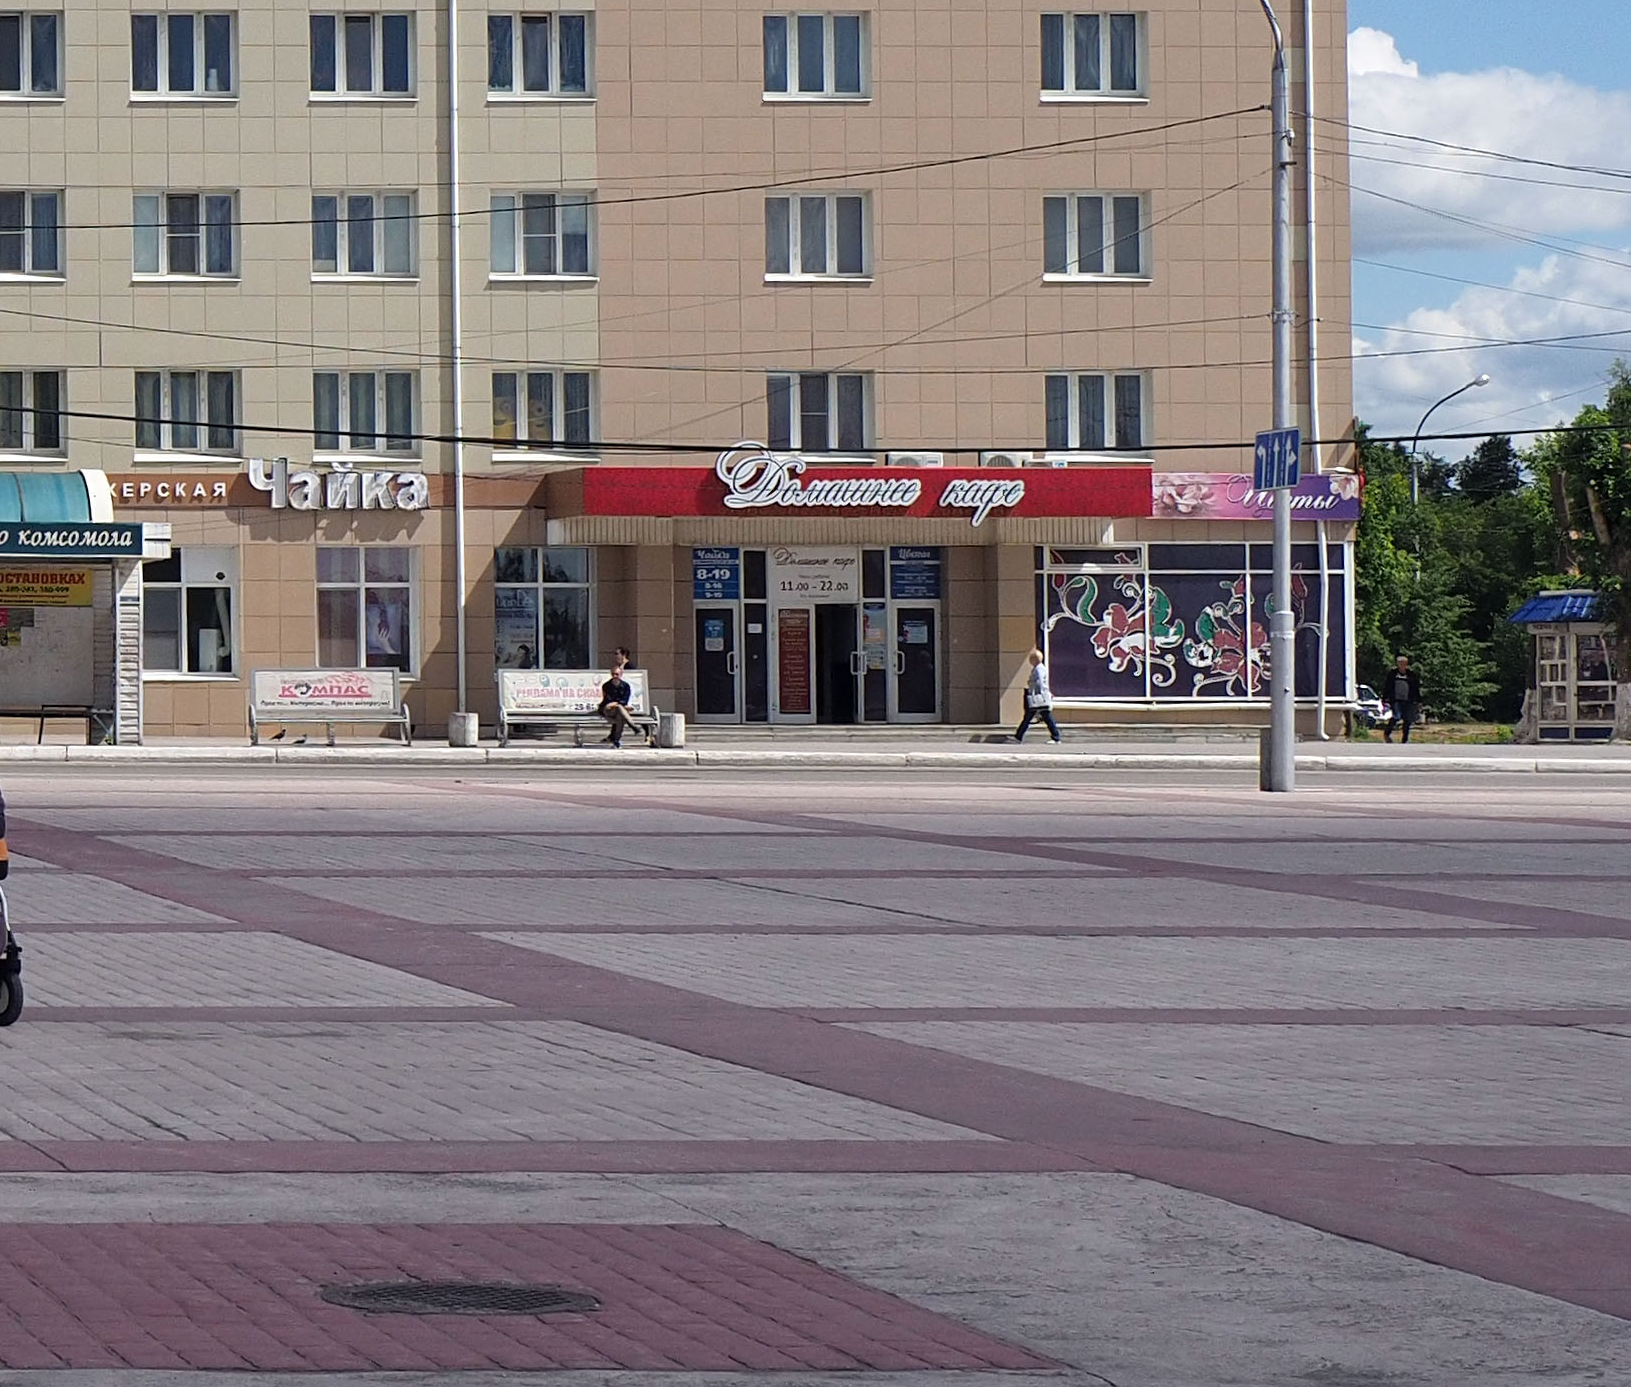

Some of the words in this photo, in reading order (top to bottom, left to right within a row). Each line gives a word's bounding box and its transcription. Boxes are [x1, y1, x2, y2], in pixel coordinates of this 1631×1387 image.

[249, 457, 430, 510] Чайка
[717, 441, 922, 509] Домашнее
[939, 478, 1025, 527] кафе
[18, 528, 133, 548] комсомола
[696, 568, 731, 580] 8-19
[780, 580, 810, 591] 11.00
[281, 682, 369, 695] КОМПАС
